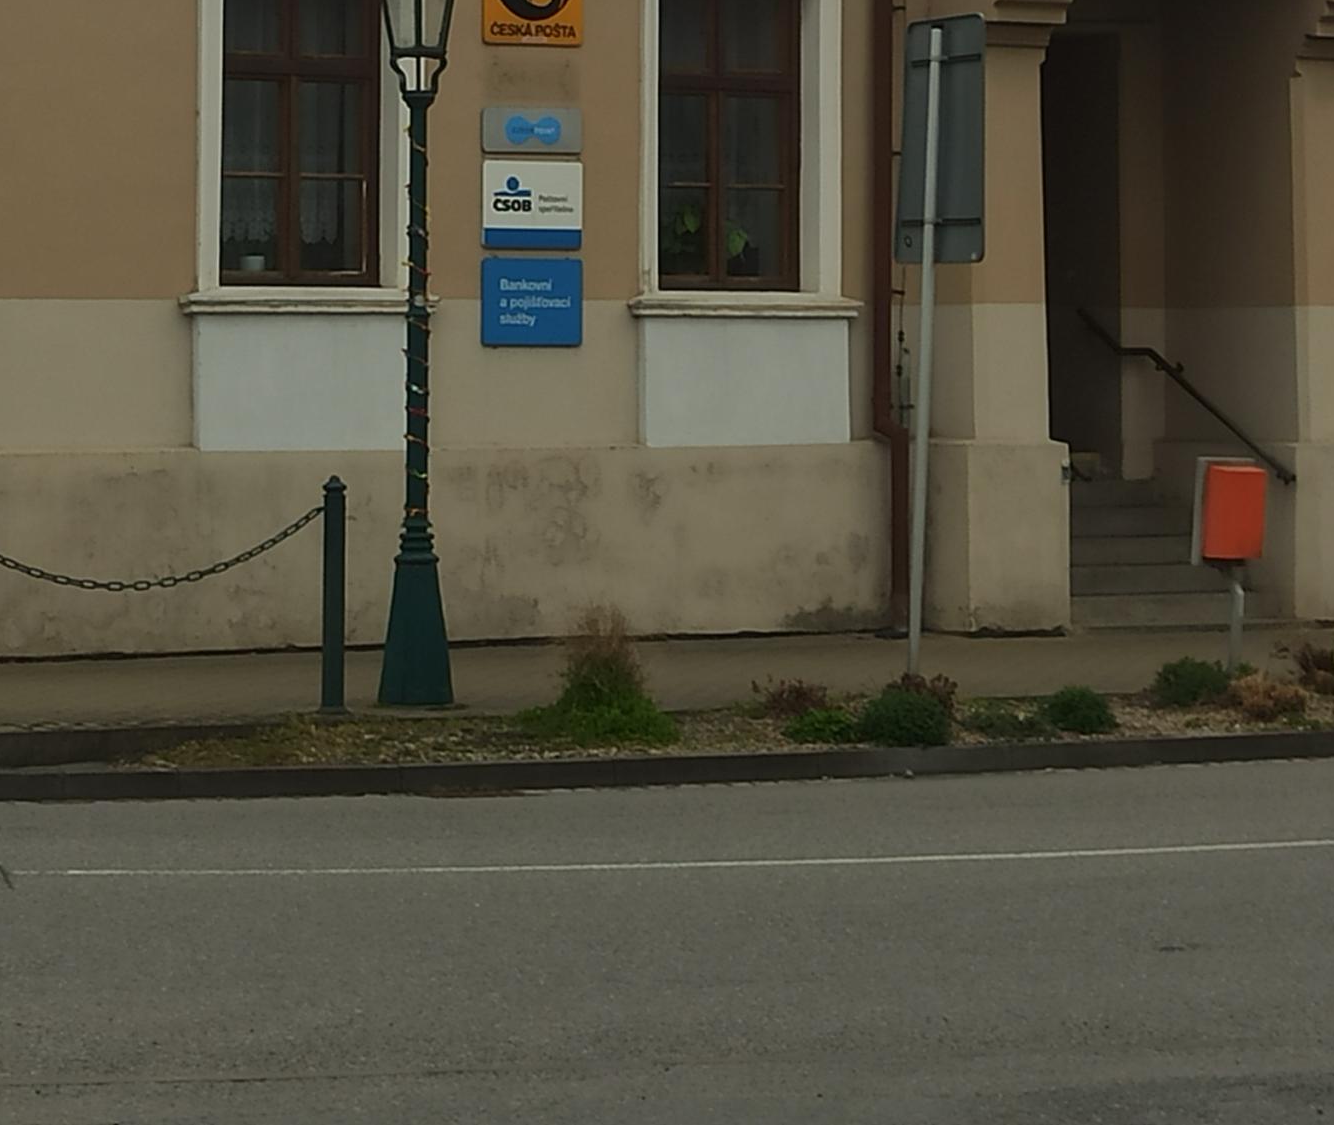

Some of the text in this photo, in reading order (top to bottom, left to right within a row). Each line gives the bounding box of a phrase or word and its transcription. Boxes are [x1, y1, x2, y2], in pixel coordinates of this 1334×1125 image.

[490, 21, 576, 38] ČESKÁ POŠTA
[499, 278, 552, 291] Bankovní
[499, 295, 572, 311] a pojišťovací
